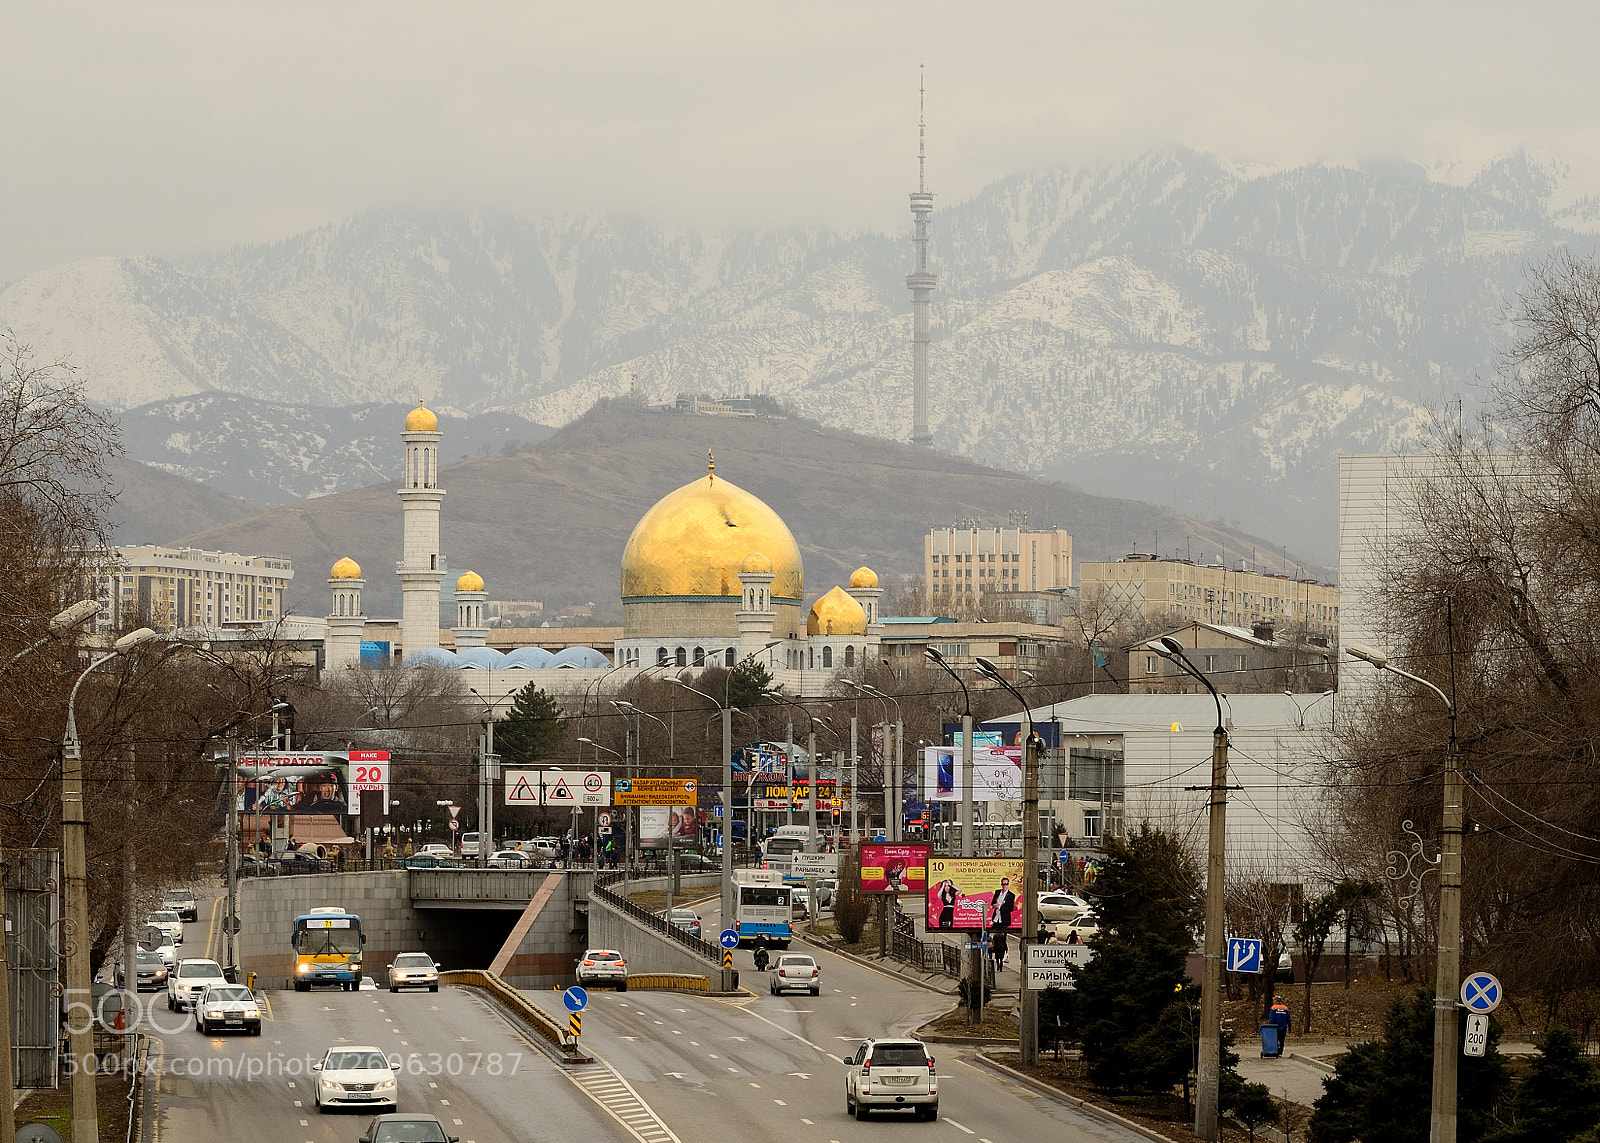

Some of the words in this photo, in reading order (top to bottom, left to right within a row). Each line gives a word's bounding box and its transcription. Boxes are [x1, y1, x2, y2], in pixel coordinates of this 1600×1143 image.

[238, 757, 324, 767] РЕГИСТРАТОР
[356, 766, 382, 782] 20
[765, 786, 809, 798] ЛОМБАР
[818, 786, 830, 798] 24
[932, 861, 945, 871] 10
[979, 860, 1007, 868] ДАЙНЕКО
[1032, 949, 1078, 958] ПУШКИН
[1032, 970, 1076, 980] РАЙЫМ
[1468, 1032, 1484, 1044] 200
